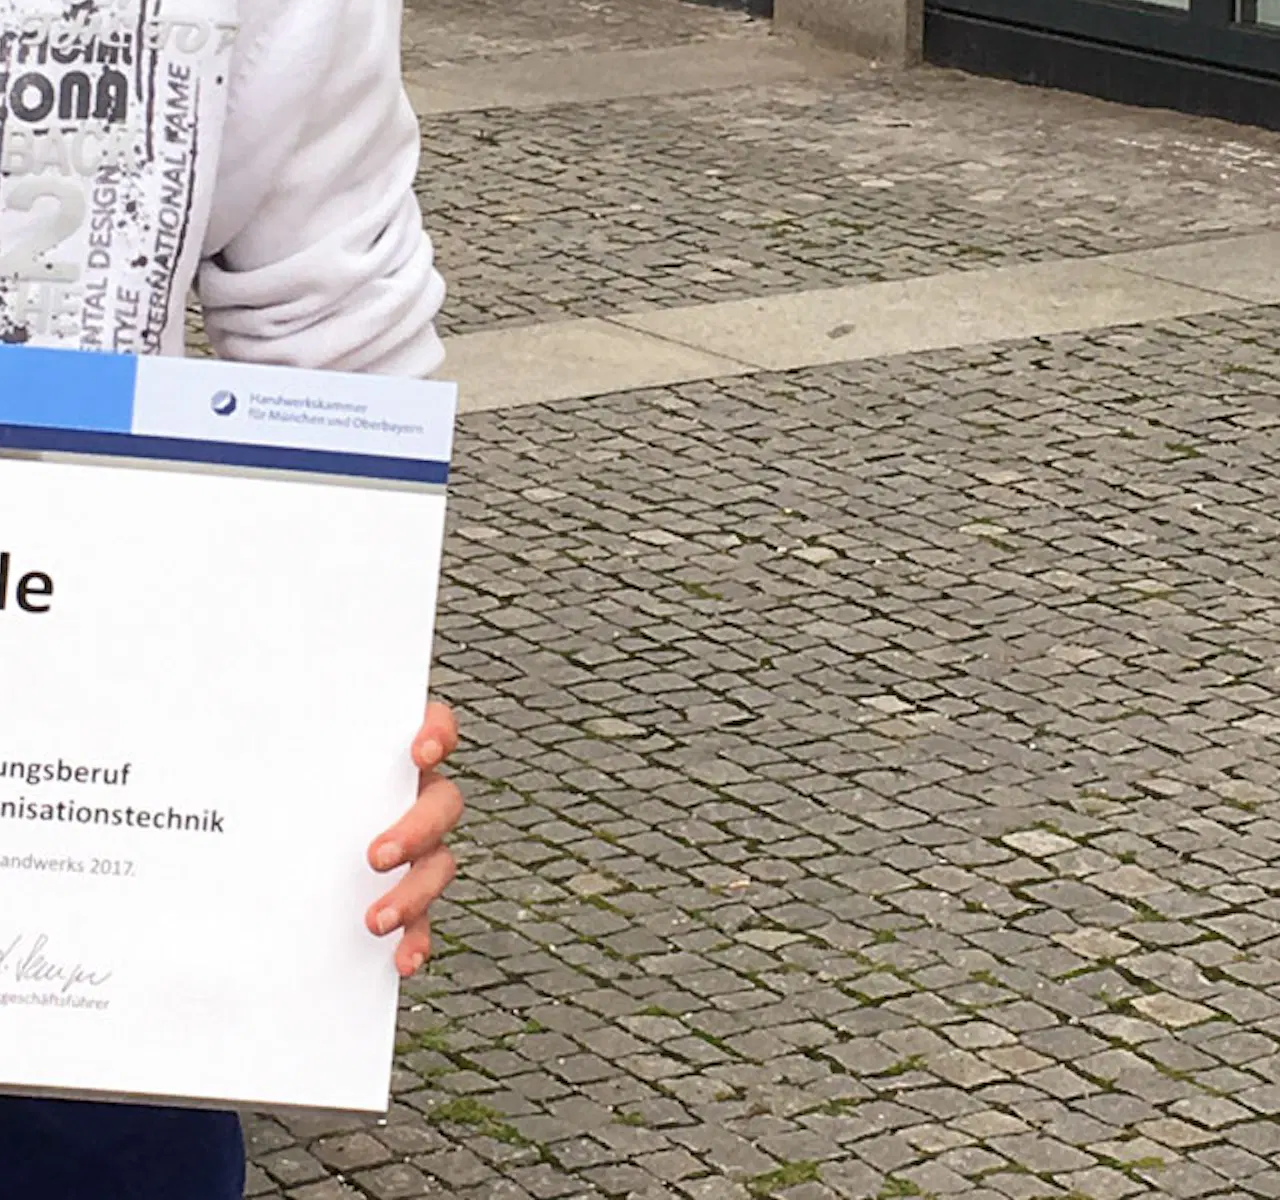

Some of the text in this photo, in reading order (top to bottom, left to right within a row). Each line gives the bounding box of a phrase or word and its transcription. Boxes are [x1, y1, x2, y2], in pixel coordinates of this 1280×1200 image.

[165, 61, 191, 144] FAME
[88, 164, 119, 269] DESIGN
[247, 407, 266, 421] für
[267, 409, 326, 427] München
[327, 416, 351, 429] und
[248, 392, 369, 415] Handwerkskammer
